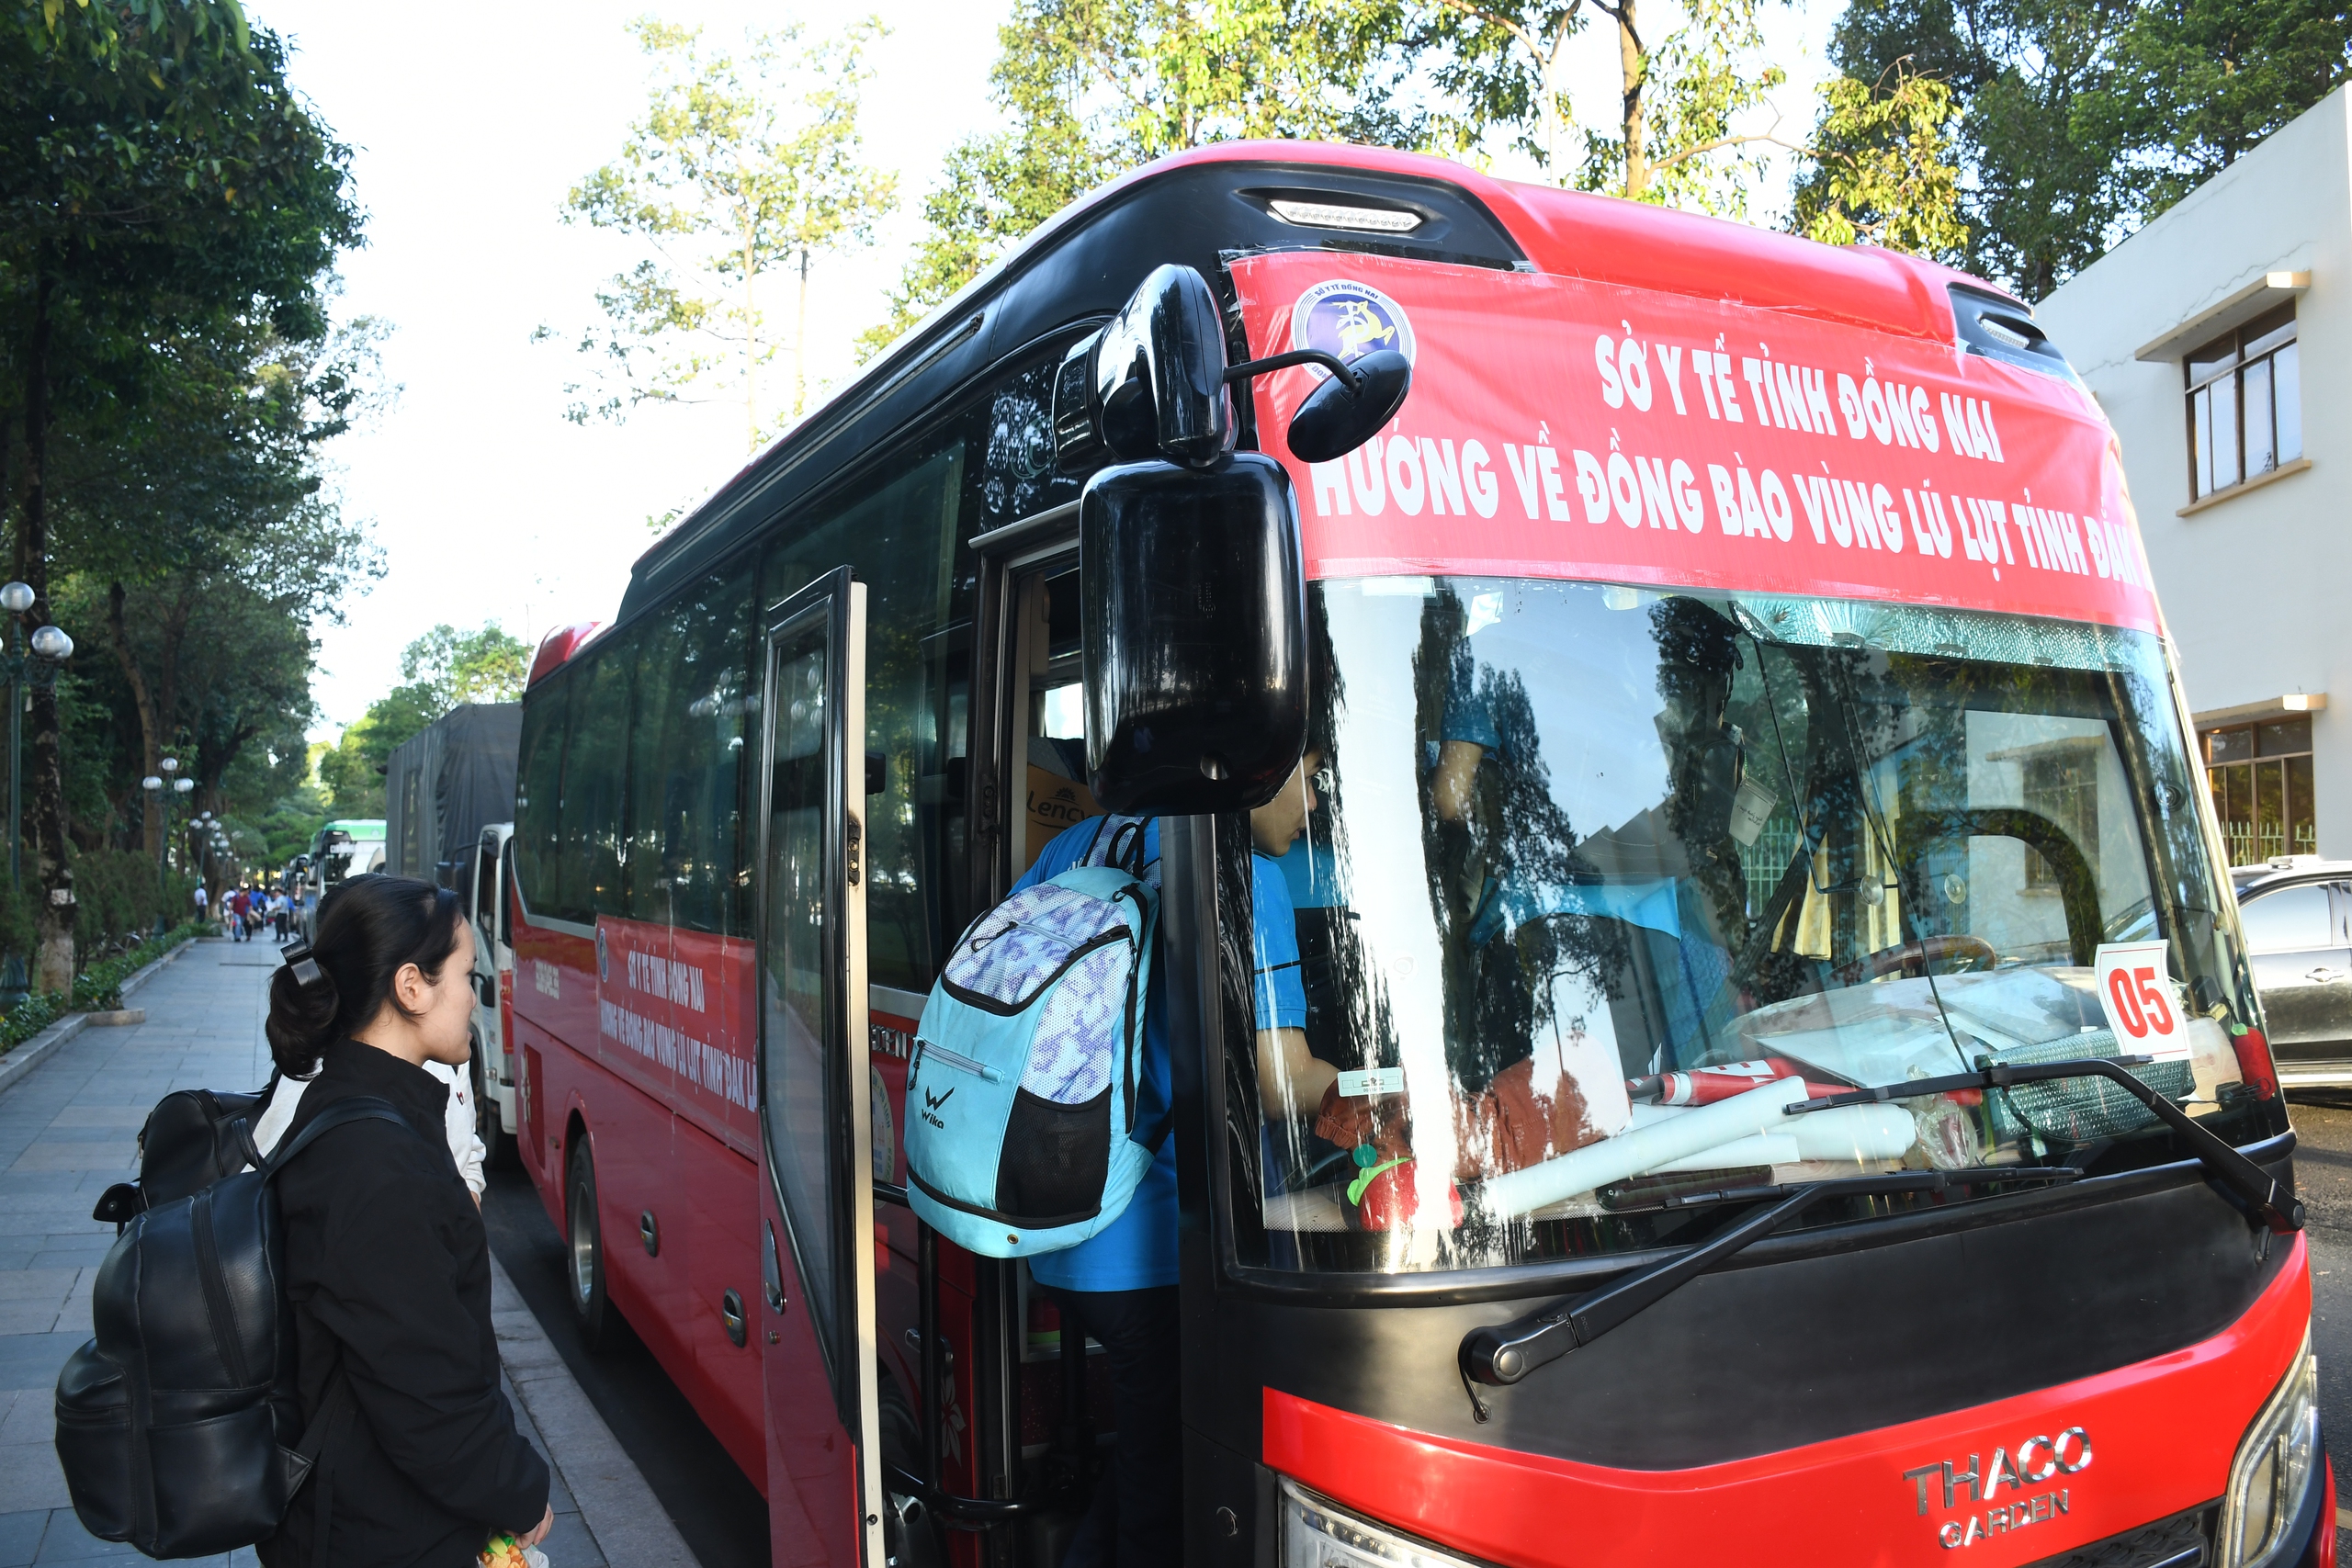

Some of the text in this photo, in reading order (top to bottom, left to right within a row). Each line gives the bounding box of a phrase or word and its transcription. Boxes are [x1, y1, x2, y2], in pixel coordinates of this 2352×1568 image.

[1311, 365, 1329, 378] DON
[1594, 319, 2005, 464] SỞ Y TẾ TỈNH ĐỒNG NAI
[1309, 418, 1499, 520] HƯỚNG
[1503, 420, 1570, 522] VỀ
[1573, 427, 1704, 535] ĐỒNG
[1707, 450, 1793, 544] BÀO
[1792, 460, 1904, 554] VÙNG
[1903, 478, 1952, 559] LŨ
[1951, 494, 2015, 581] LỤT
[2011, 487, 2089, 576] TỈNH
[2109, 966, 2174, 1039] 05
[1902, 1426, 2093, 1517] THACO
[1938, 1488, 2070, 1551] GARDEN
